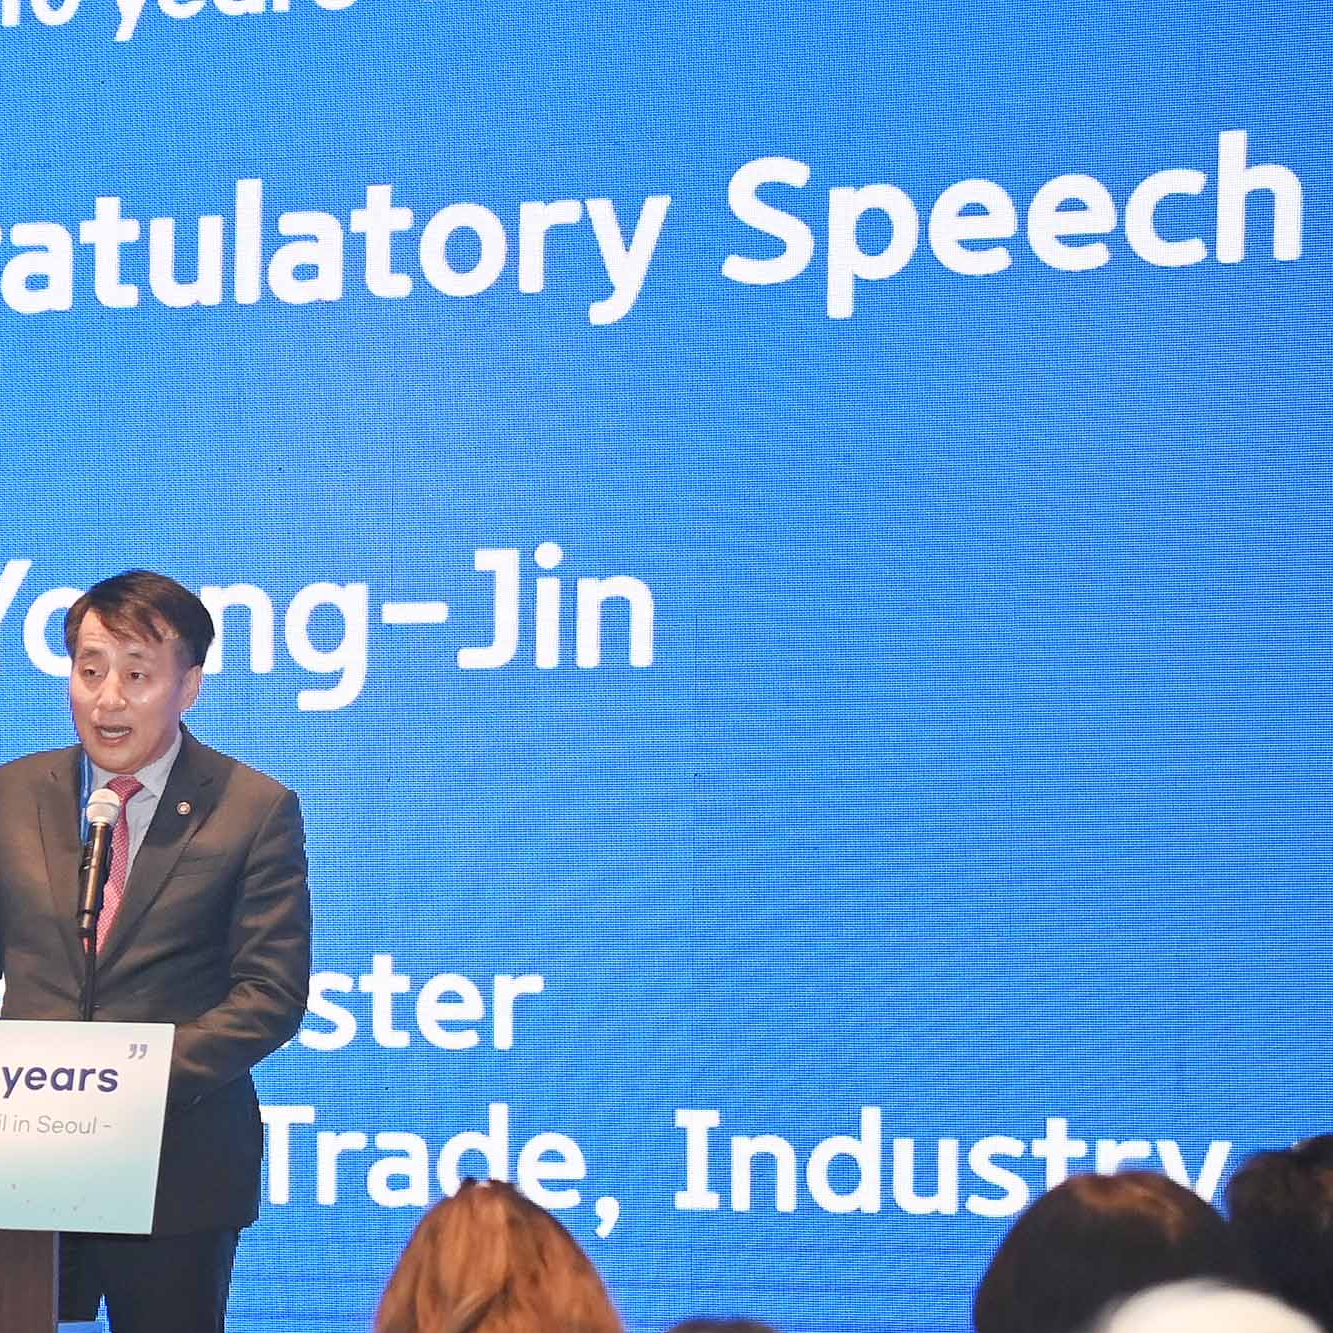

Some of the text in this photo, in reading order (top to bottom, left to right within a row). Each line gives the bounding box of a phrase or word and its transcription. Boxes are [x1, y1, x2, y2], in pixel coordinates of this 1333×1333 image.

[722, 130, 1304, 319] Speech
[13, 1113, 31, 1133] in
[36, 1114, 98, 1135] Seoul
[259, 1102, 620, 1239] Trade,
